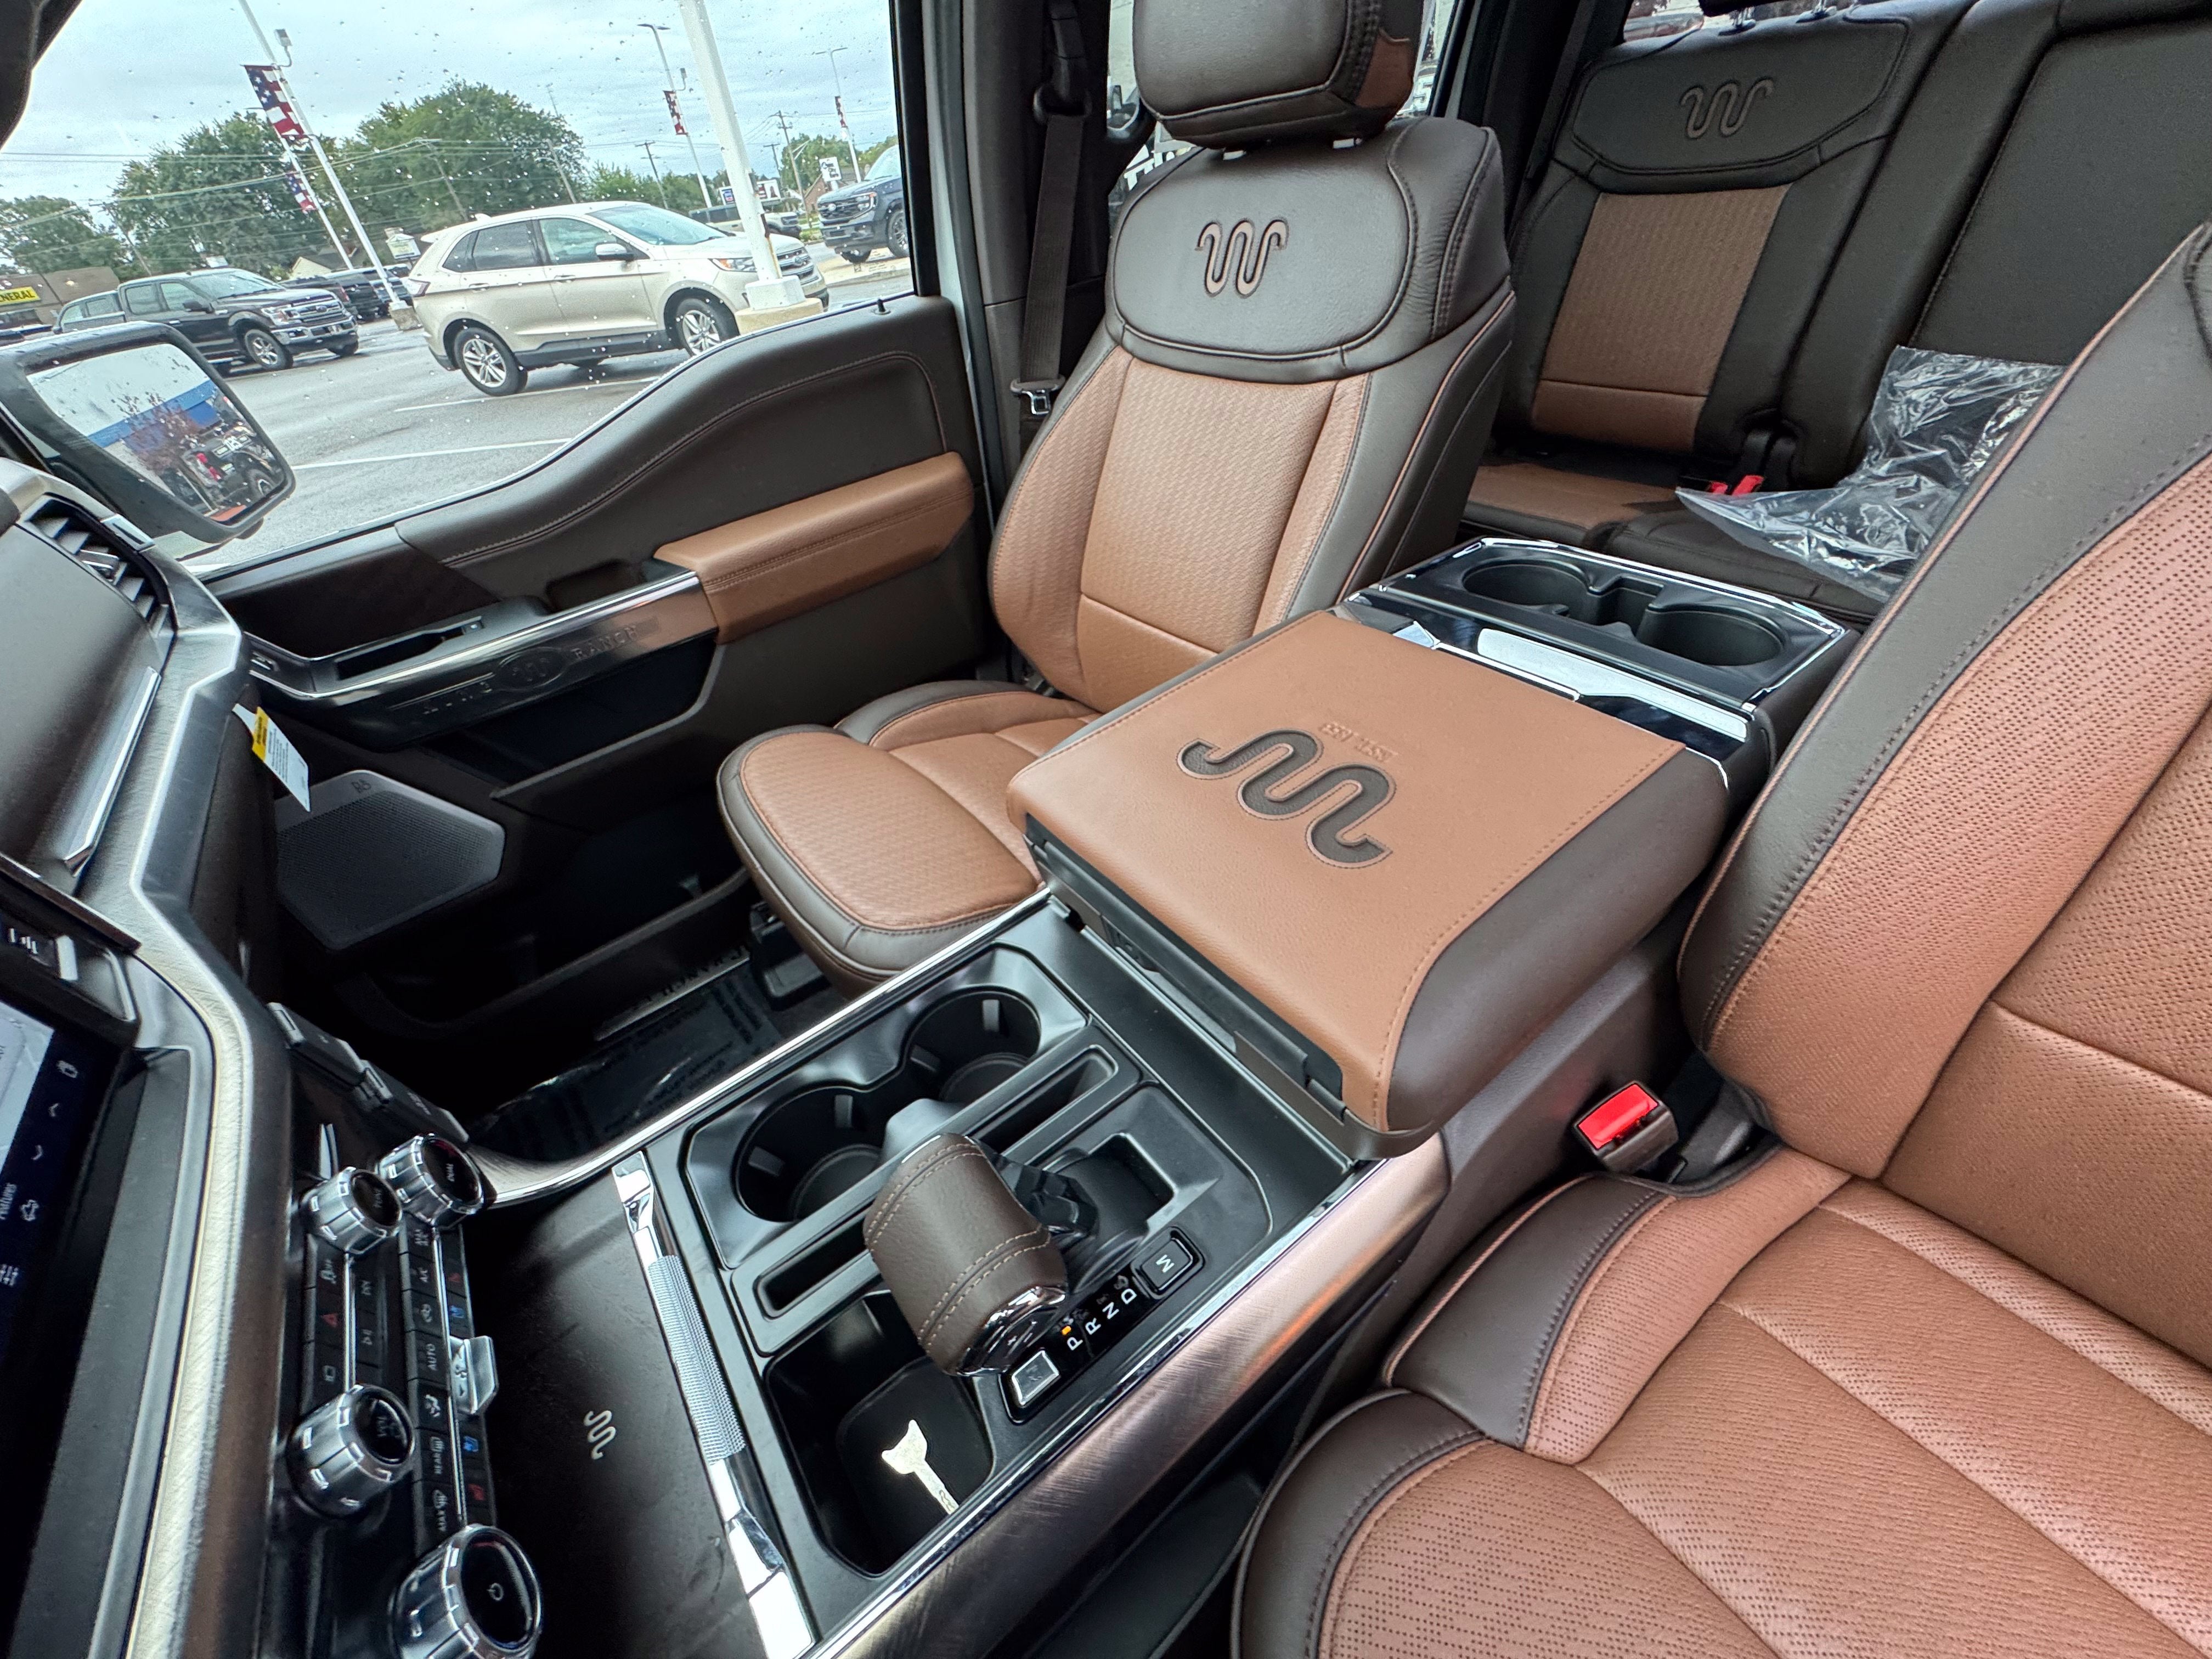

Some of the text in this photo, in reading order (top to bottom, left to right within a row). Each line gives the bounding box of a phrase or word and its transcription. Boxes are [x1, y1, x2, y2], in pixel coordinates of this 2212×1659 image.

[1066, 1288, 1137, 1351] P R N D
[425, 1343, 438, 1372] AUTO
